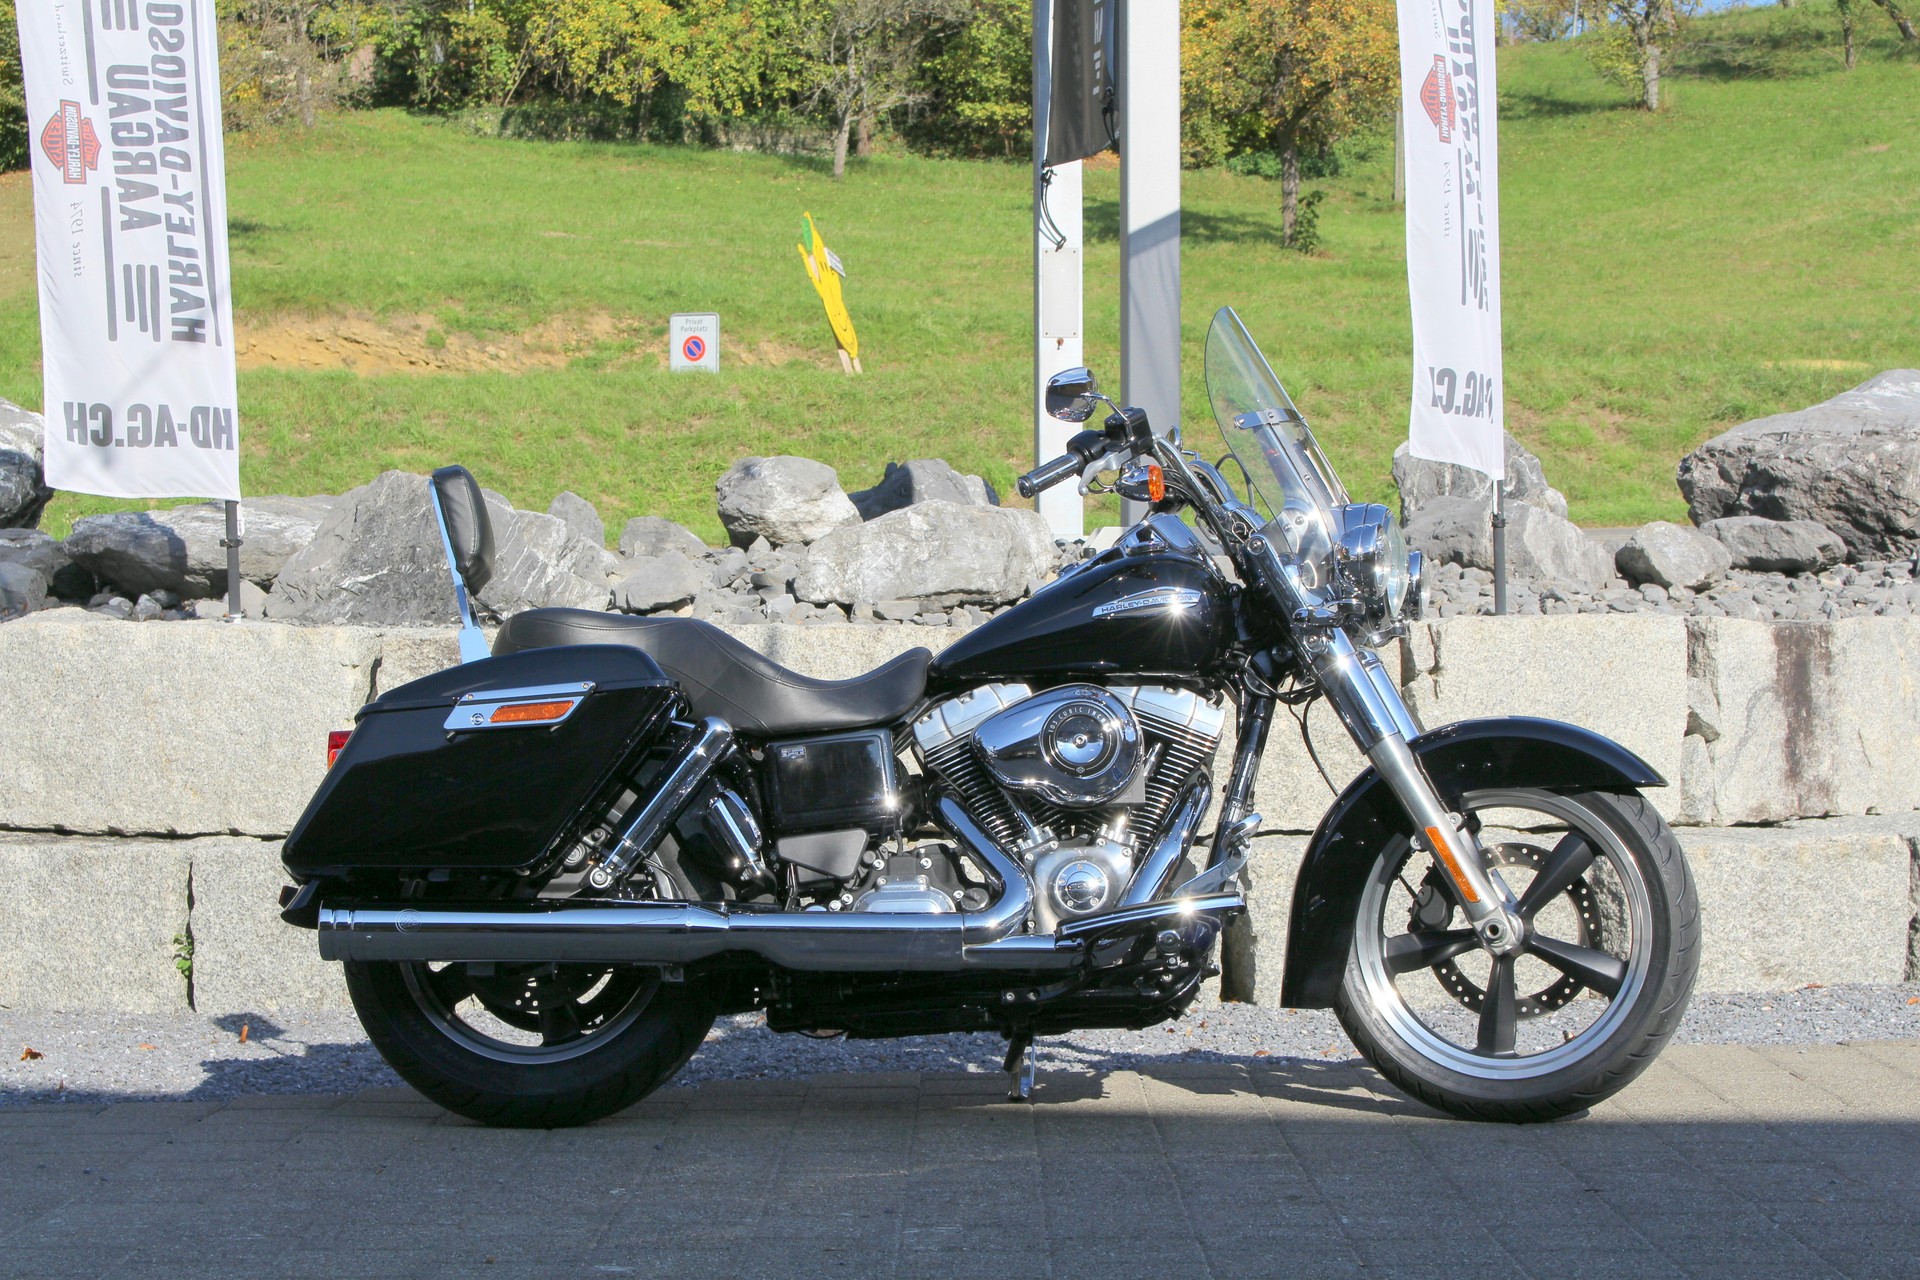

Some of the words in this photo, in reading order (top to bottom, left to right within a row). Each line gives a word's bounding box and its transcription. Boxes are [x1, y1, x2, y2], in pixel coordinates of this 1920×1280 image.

[680, 325, 708, 333] Parkplatz
[1048, 720, 1058, 733] 103
[1058, 707, 1083, 719] CUBIC
